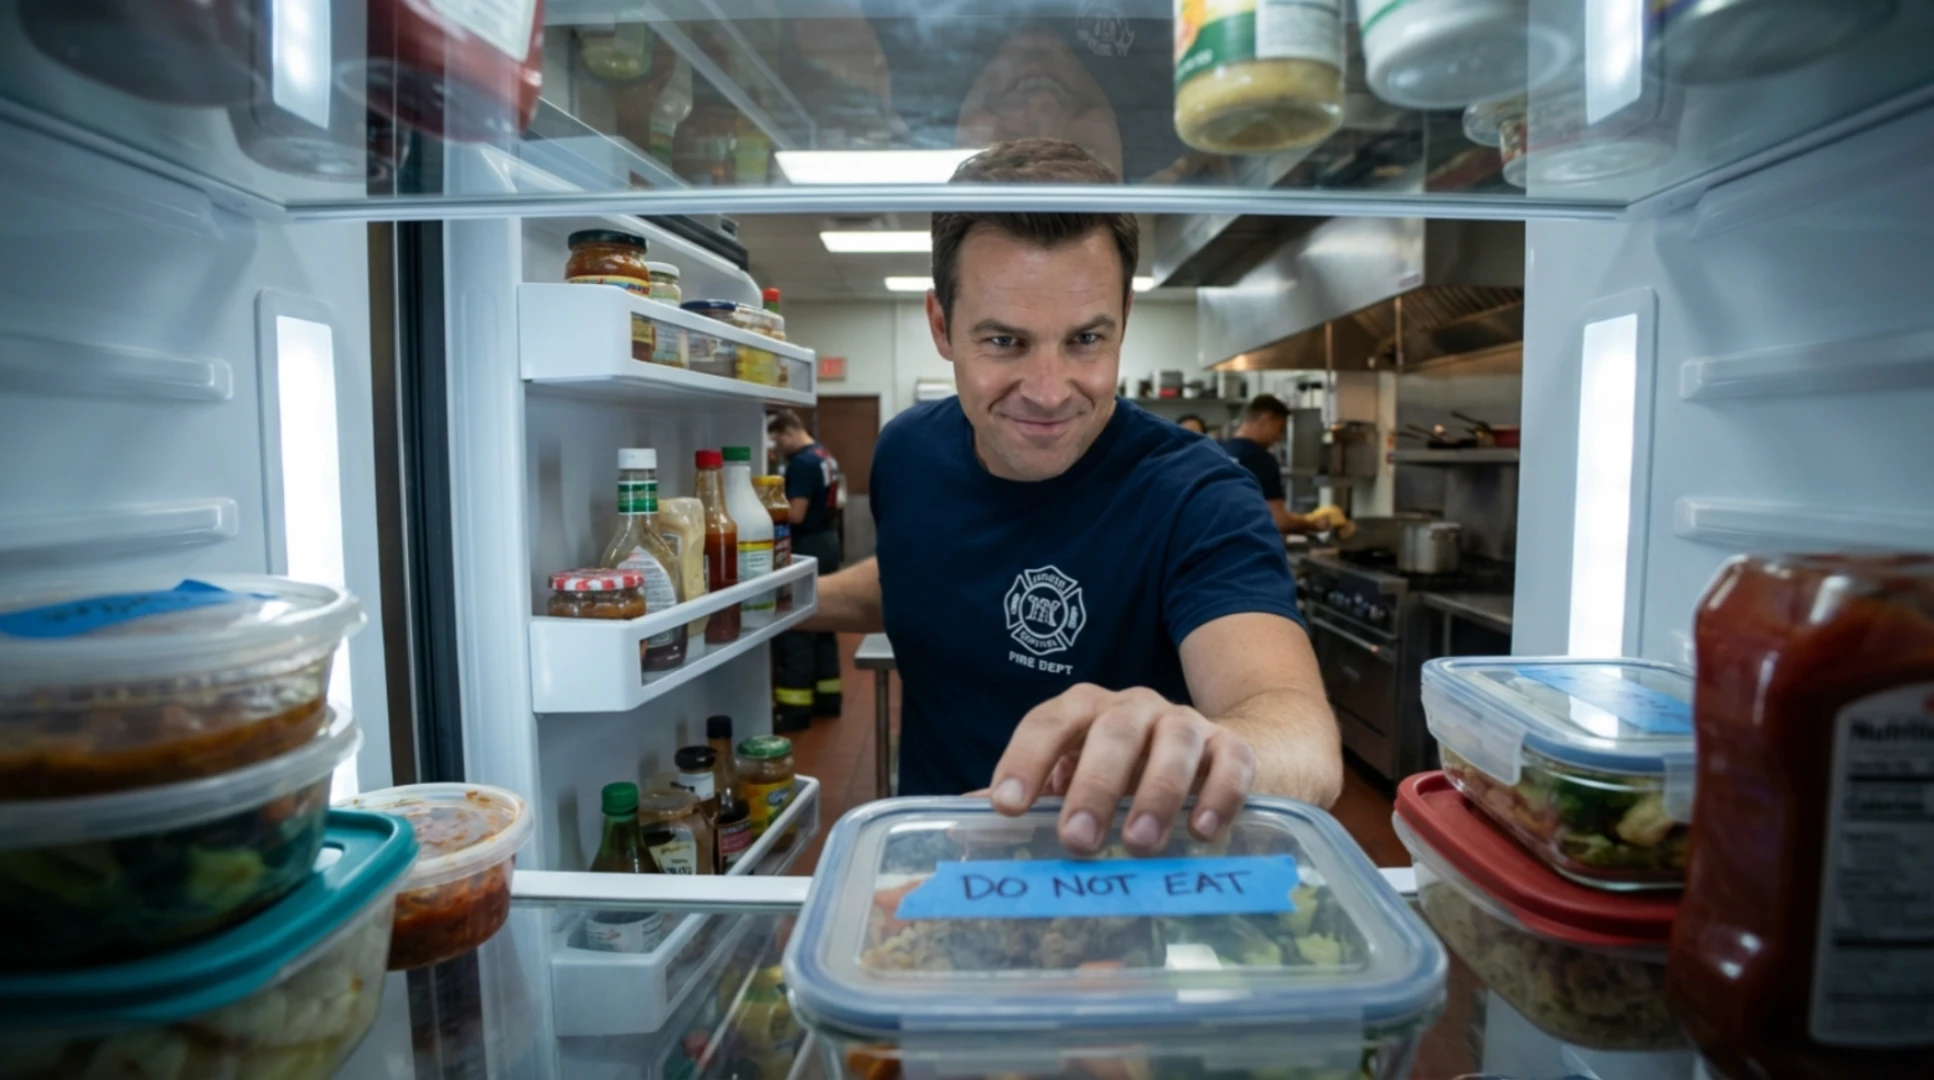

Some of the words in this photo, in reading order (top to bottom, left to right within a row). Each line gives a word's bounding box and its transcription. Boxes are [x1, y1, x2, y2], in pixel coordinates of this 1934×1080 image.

[1038, 659, 1074, 675] DEPT
[961, 872, 1029, 901] DO
[1051, 872, 1138, 900] NOT
[1163, 869, 1253, 897] EAT
